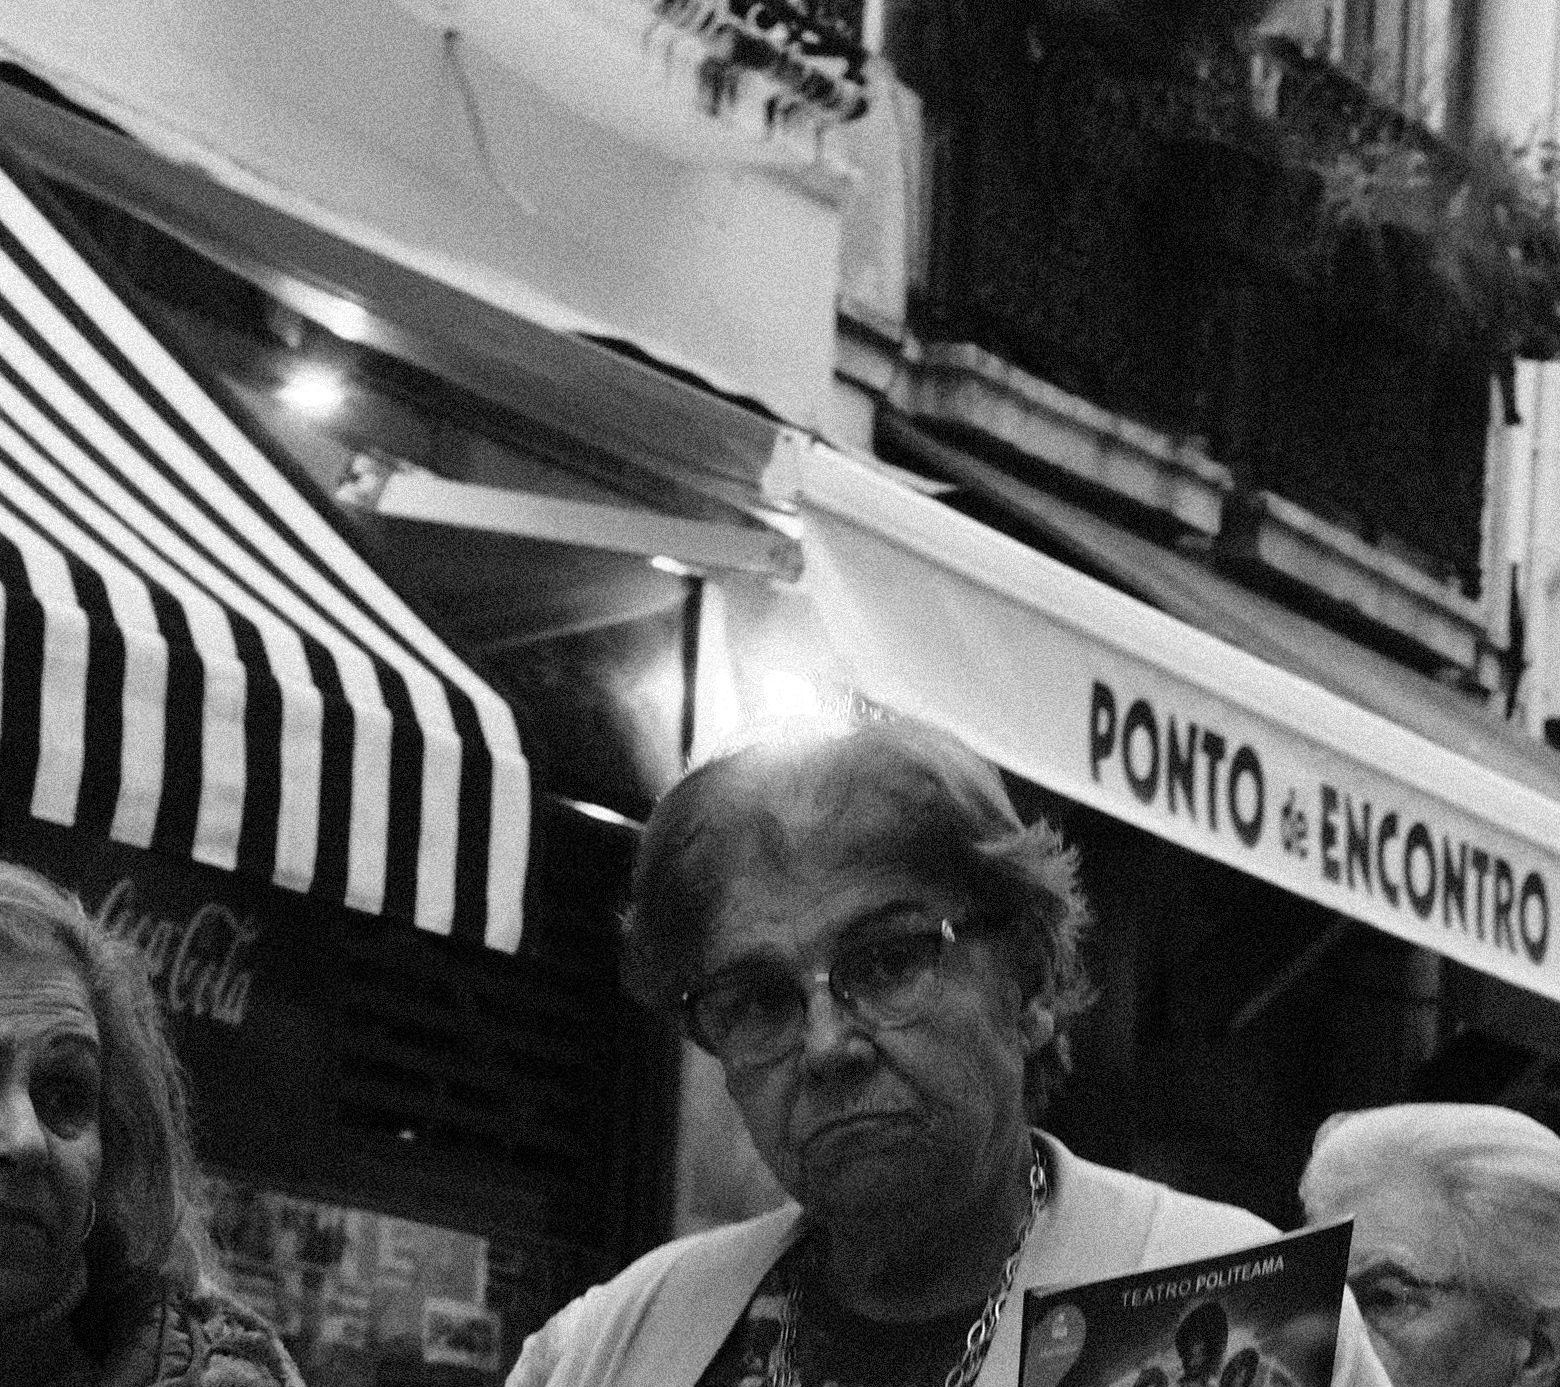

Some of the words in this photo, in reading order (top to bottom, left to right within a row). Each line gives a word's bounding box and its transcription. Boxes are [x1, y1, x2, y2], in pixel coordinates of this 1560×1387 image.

[1090, 679, 1265, 848] PONTO
[1280, 785, 1309, 860] de
[1319, 783, 1550, 965] ENCONTRO
[1121, 1277, 1192, 1308] TEATRO
[1195, 1254, 1285, 1293] POLITEAMA
